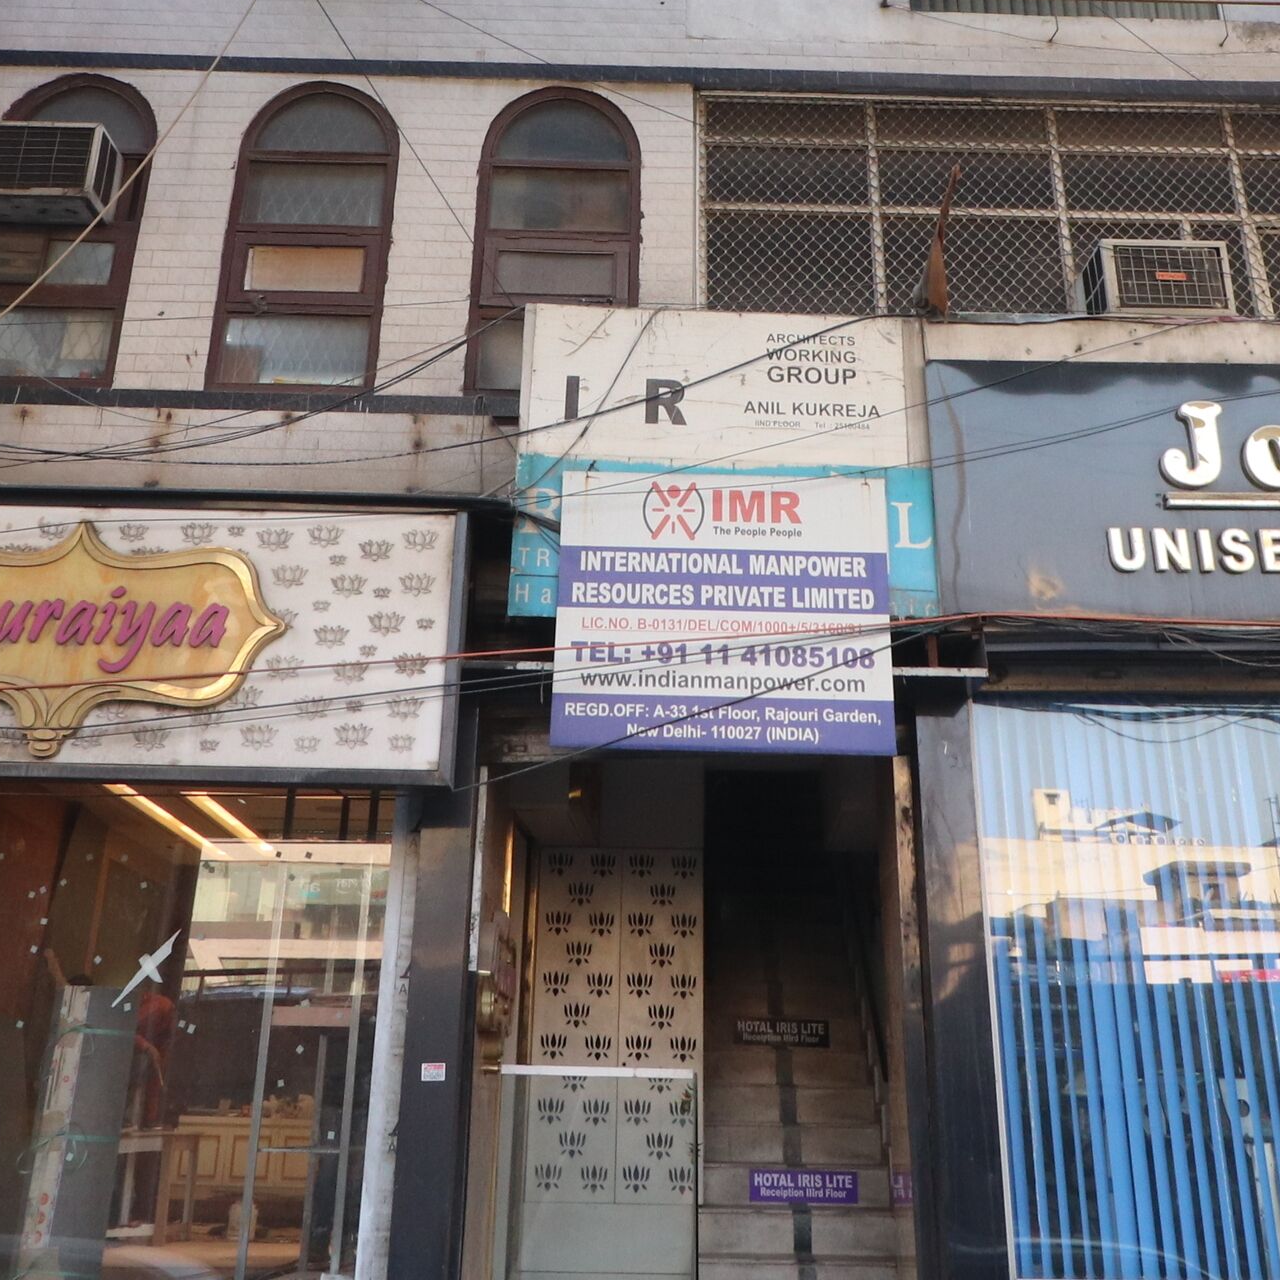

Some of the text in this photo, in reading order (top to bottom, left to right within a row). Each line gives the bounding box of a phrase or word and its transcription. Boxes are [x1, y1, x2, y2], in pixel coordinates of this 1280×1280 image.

[766, 332, 856, 347] ARCHITECTS
[766, 348, 857, 364] WORKING
[767, 366, 857, 386] GROUP
[644, 378, 687, 426] R
[743, 400, 881, 419] ANIL KUKREJA
[711, 489, 803, 525] IMR
[713, 525, 803, 539] The People People
[580, 550, 868, 579] INTERNATIONAL MANPOWER
[571, 581, 695, 607] RESOURCES
[700, 585, 787, 609] PRIVATE
[792, 587, 876, 611] LIMITED
[581, 616, 633, 631] LIC.NO.
[570, 640, 876, 670] TEL: +91 11 41085108
[580, 669, 866, 694] www.indianmanpower.com
[564, 702, 650, 719] REGD.OFF:
[765, 707, 819, 725] Rajouri
[822, 709, 883, 727] Garden,
[663, 725, 707, 740] Delhi-
[711, 726, 761, 741] 110027
[766, 727, 820, 744] (INDIA)
[737, 1019, 825, 1036] HOTAL IRIS LITE
[753, 1172, 853, 1189] HOTAL IRIS LITE
[825, 1187, 847, 1199] Floor
